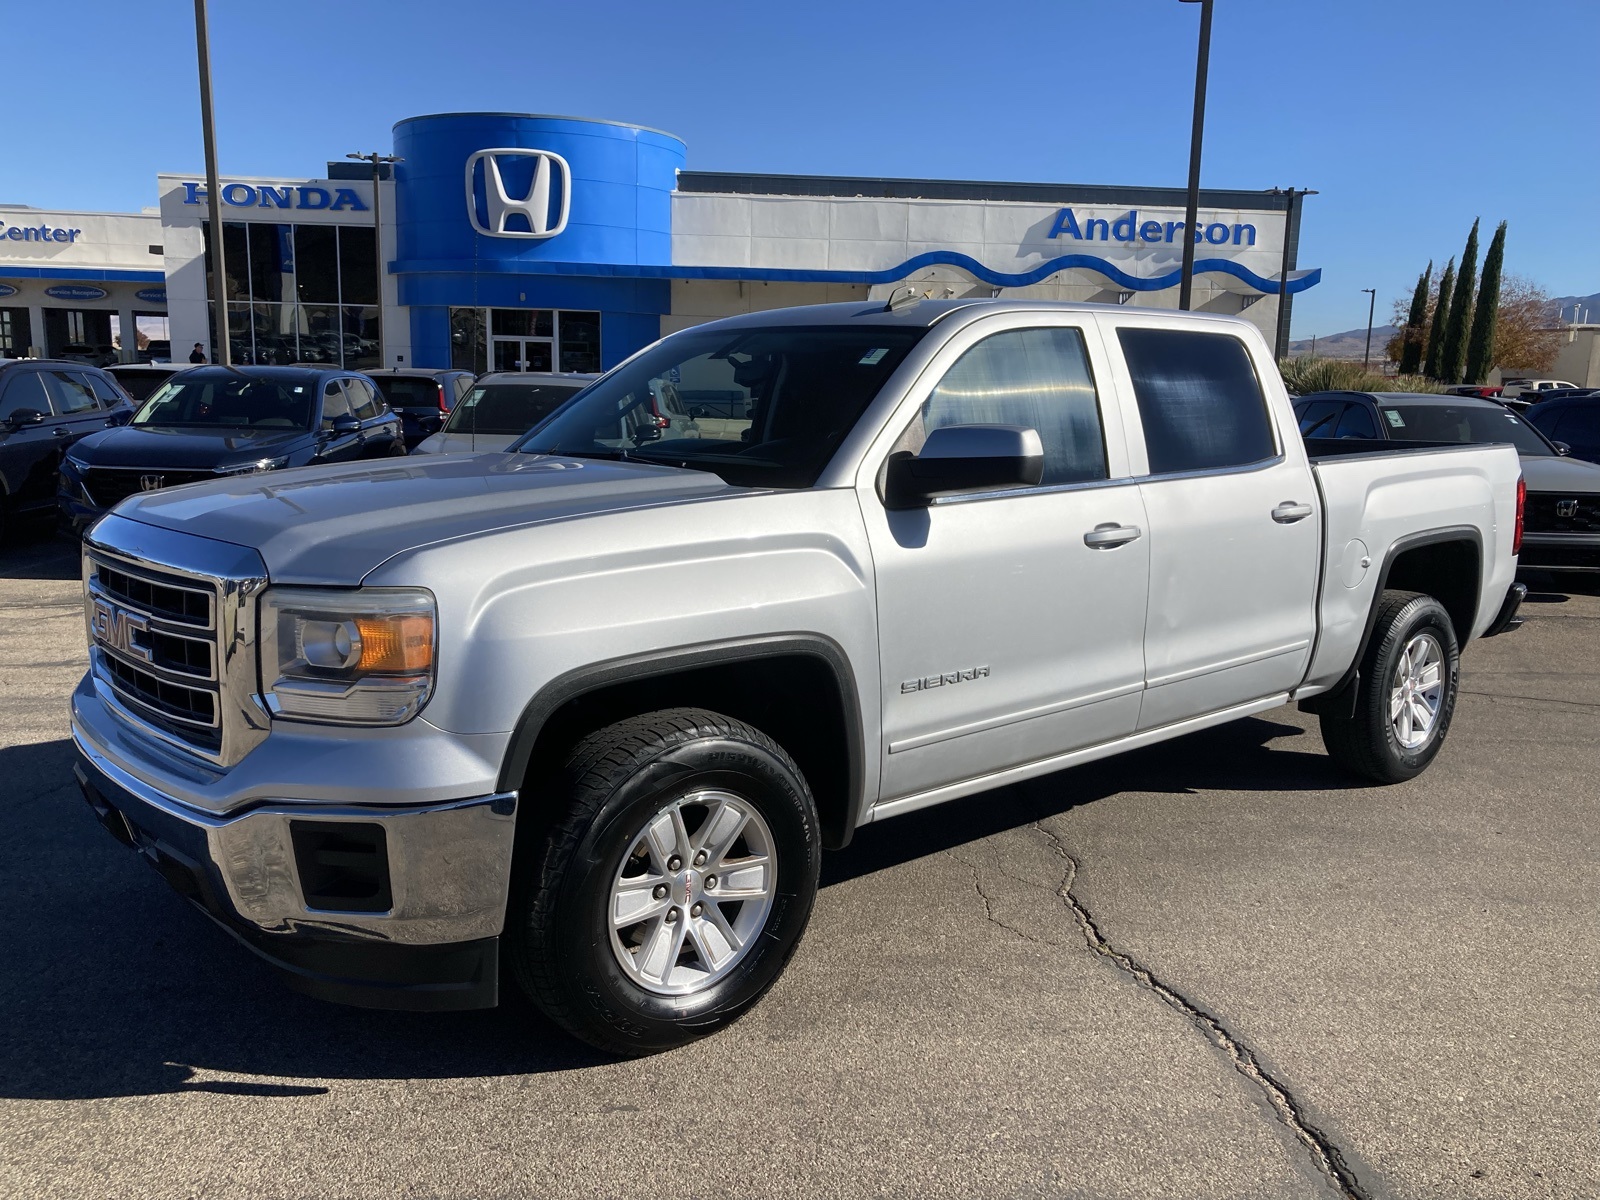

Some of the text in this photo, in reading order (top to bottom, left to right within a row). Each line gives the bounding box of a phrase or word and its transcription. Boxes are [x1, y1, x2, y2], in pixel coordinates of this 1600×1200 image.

[182, 182, 369, 212] HONDA
[72, 289, 103, 297] Reception
[93, 597, 153, 662] GMC
[900, 664, 990, 695] SIERRA
